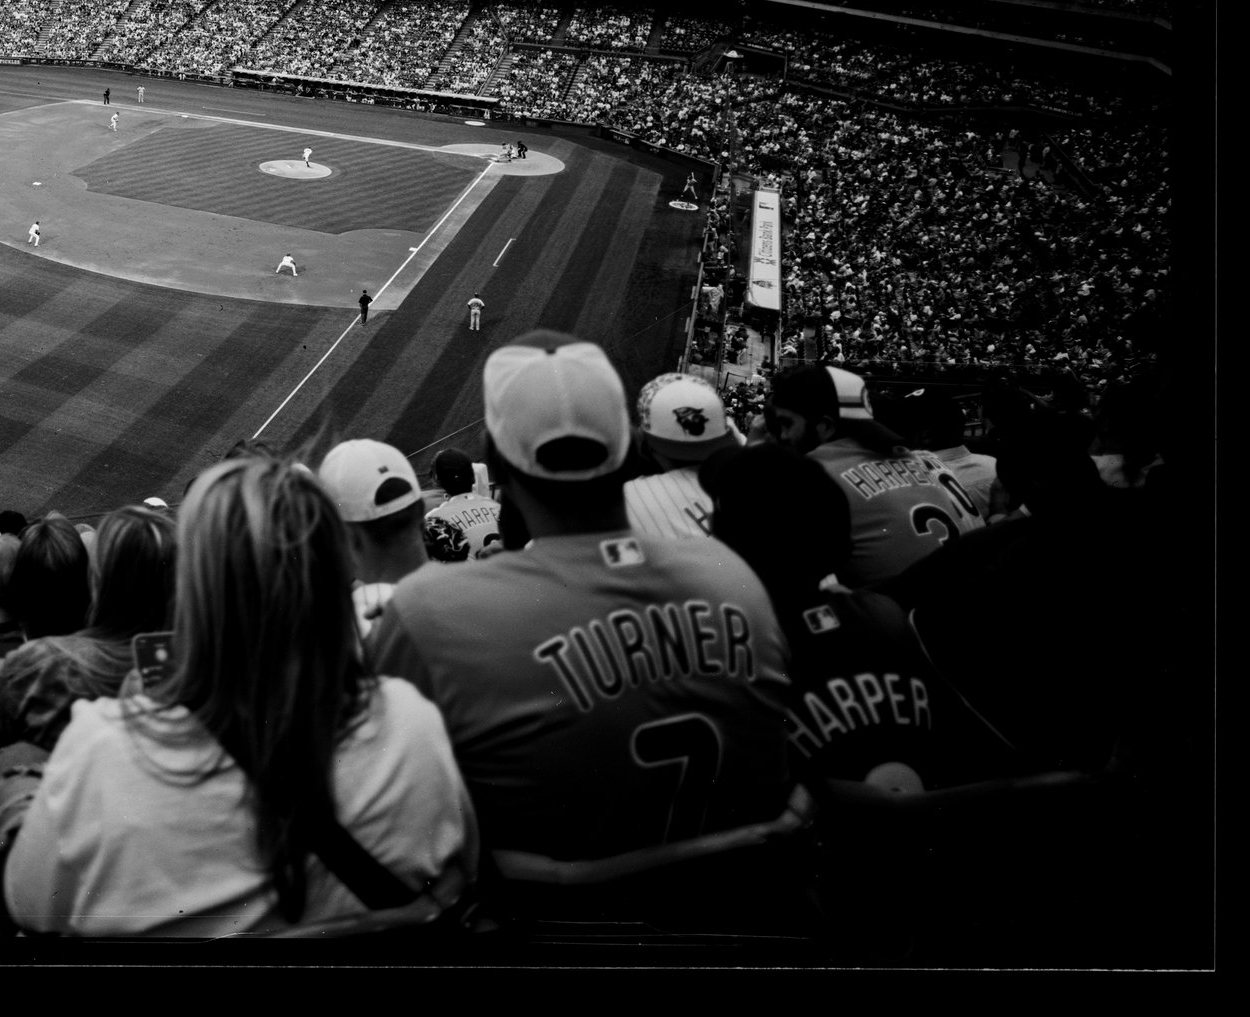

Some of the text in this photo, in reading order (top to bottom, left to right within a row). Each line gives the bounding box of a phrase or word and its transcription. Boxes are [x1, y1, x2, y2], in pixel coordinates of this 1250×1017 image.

[451, 507, 499, 531] HARPE
[840, 458, 934, 500] HARPE
[534, 601, 758, 712] TURNER
[784, 671, 933, 760] HARPER
[630, 711, 725, 845] 7
